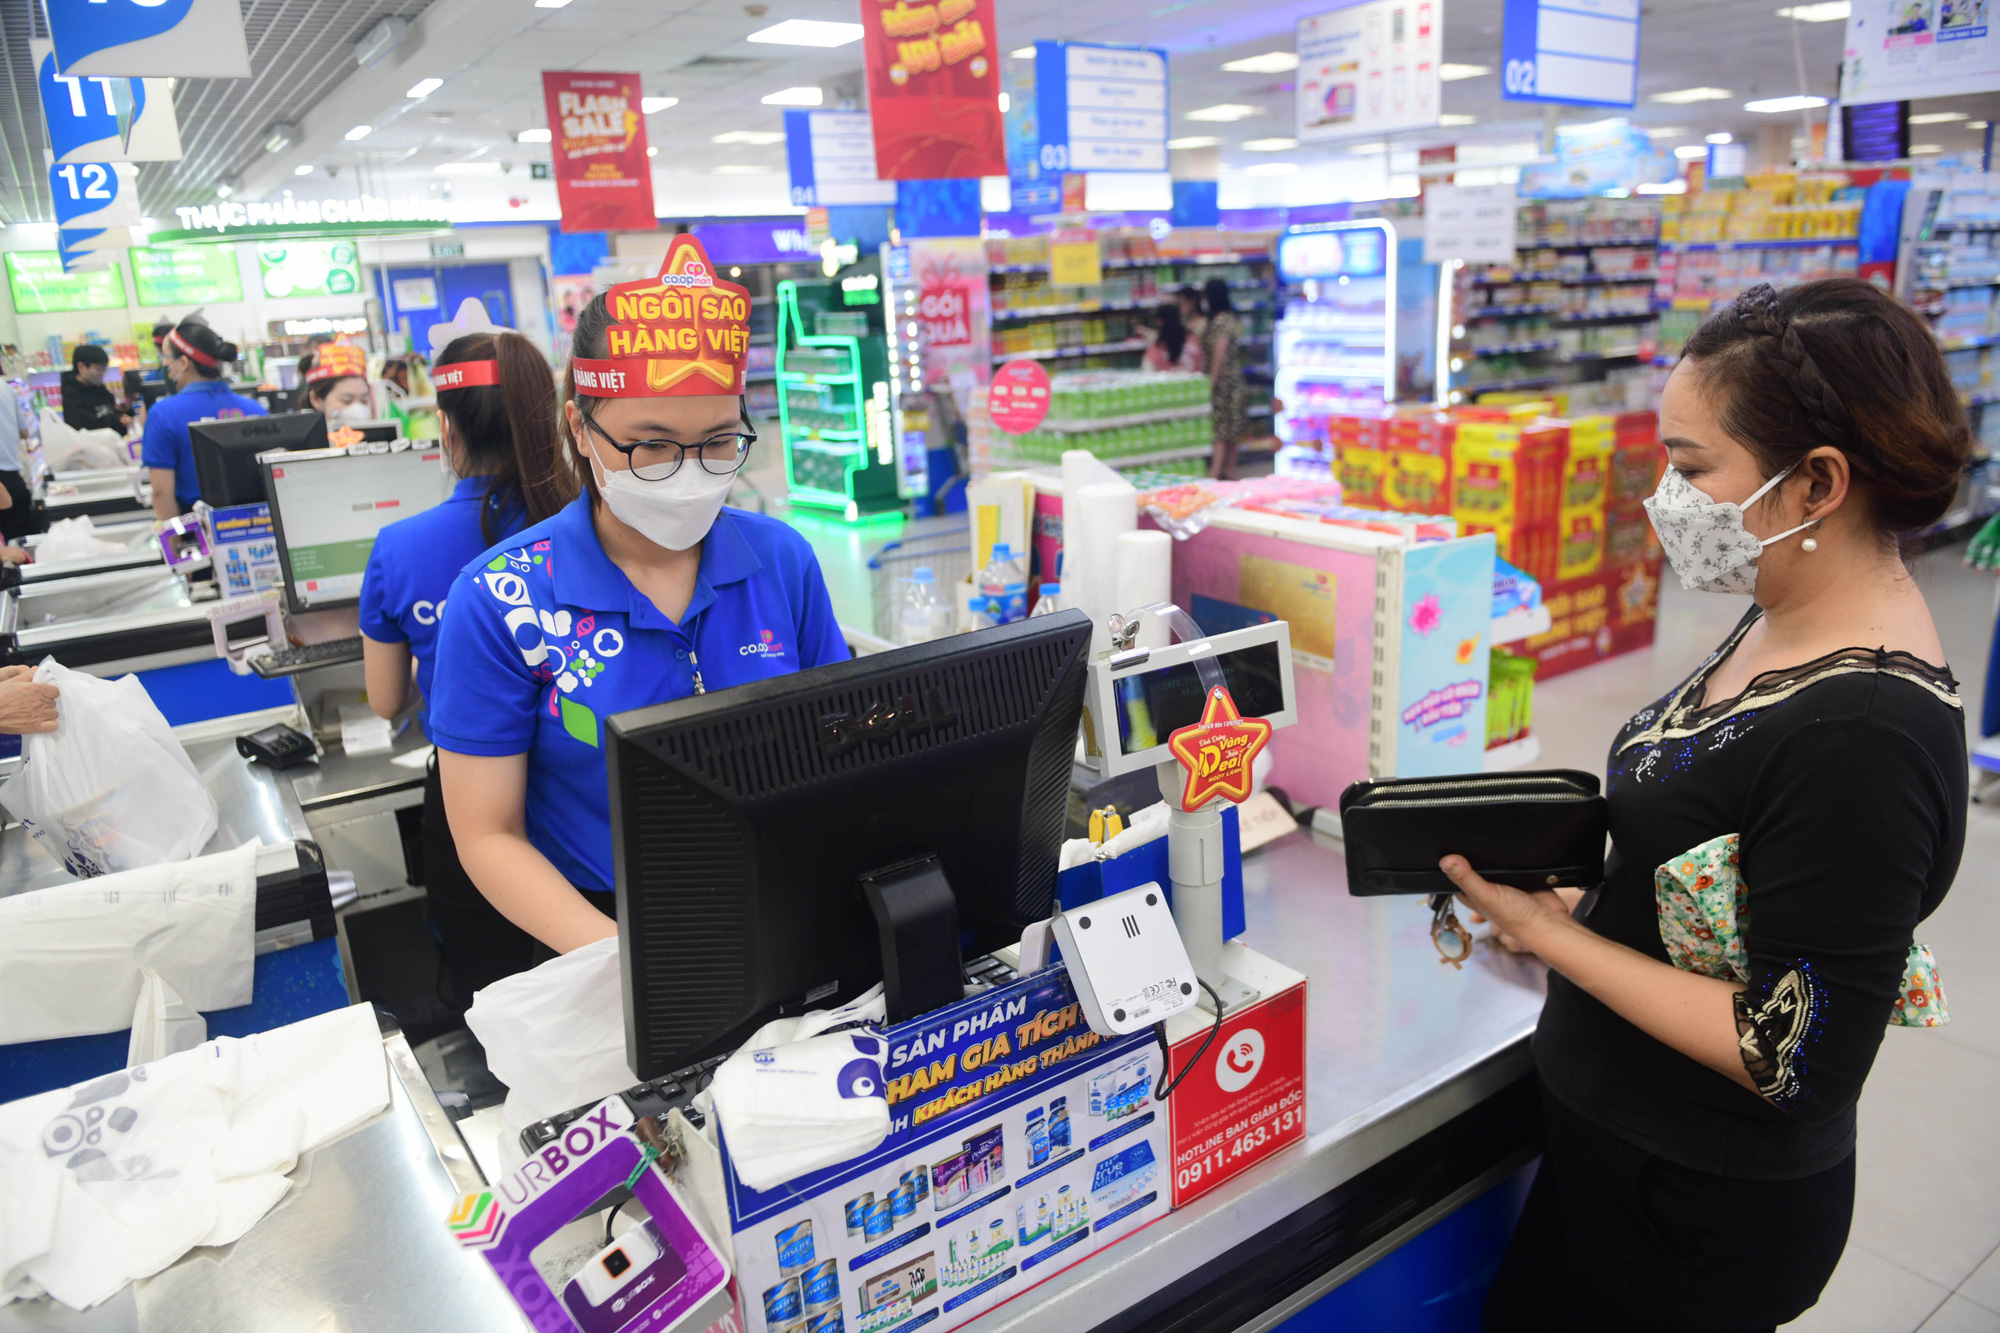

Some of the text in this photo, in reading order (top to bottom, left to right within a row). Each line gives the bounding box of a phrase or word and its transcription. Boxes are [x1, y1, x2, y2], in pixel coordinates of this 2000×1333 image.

[1505, 60, 1536, 95] 02
[558, 91, 627, 117] FLASH
[563, 110, 626, 138] SALE
[1040, 143, 1068, 170] 03
[58, 165, 112, 200] 12
[791, 185, 816, 204] 04
[616, 289, 746, 321] NGÔI SAO
[921, 289, 964, 318] GÓI
[610, 323, 749, 360] HÀNG VIỆT
[447, 369, 463, 386] VIỆT
[577, 369, 626, 393] HÀNG VIỆT
[1220, 734, 1249, 751] Vàng
[1198, 744, 1242, 778] Deal
[891, 994, 1028, 1068] SẢN PHẨM
[961, 1032, 1011, 1074] GIA
[1015, 1002, 1079, 1051] TÍCH
[914, 1080, 983, 1126] KHÁCH
[984, 1056, 1037, 1094] HÀNG
[1041, 1030, 1101, 1067] THÀNH
[1177, 1131, 1225, 1167] HOTLINE
[1225, 1118, 1249, 1140] BAN
[1249, 1102, 1278, 1125] GIÁM
[1279, 1088, 1302, 1110] ĐỐC
[499, 1105, 622, 1205] URBOX
[1177, 1104, 1302, 1190] 0911.463.131
[1093, 1170, 1125, 1190] MILK
[1095, 1161, 1124, 1181] true
[779, 1240, 811, 1261] Ensure
[624, 1273, 656, 1303] URBOX
